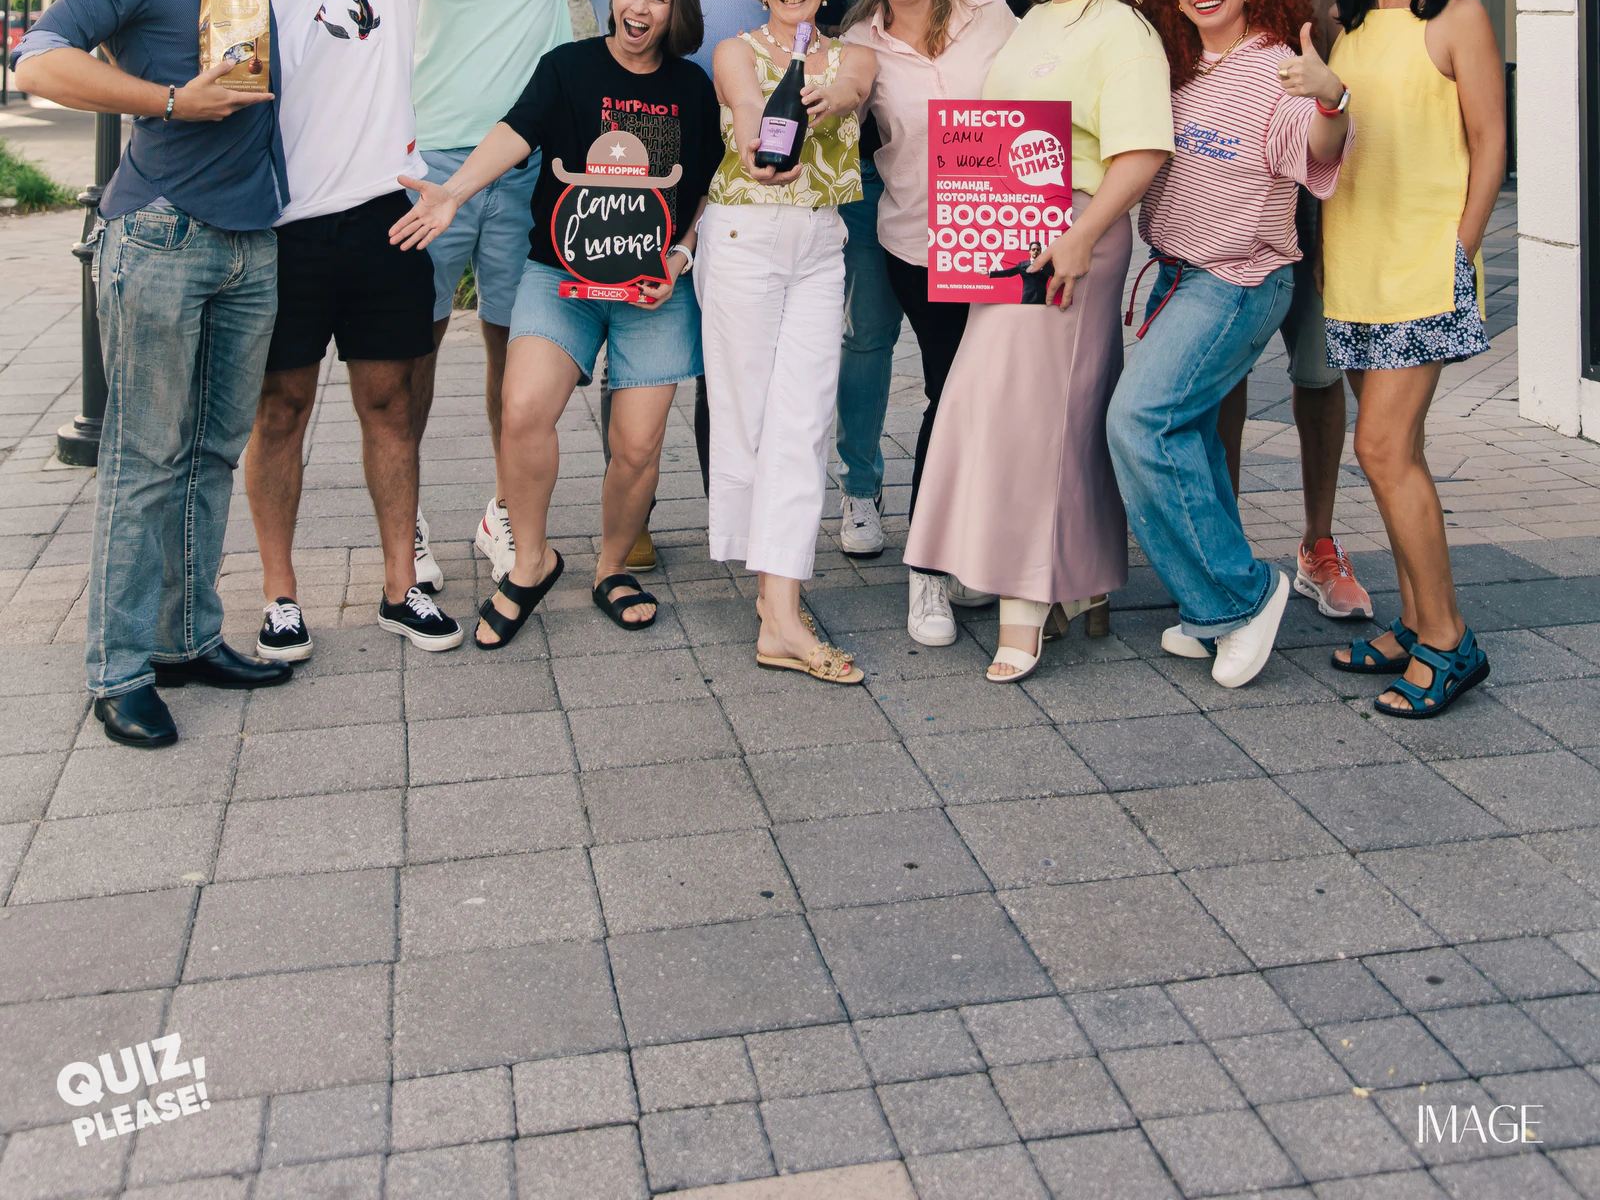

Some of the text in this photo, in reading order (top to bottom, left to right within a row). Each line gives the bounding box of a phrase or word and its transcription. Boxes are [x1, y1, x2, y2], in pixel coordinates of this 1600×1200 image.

[602, 96, 679, 117] Я ИГРАЮ В
[938, 110, 1025, 128] 1 МЕСТО
[1010, 137, 1062, 162] КВИЗ,
[1189, 140, 1237, 160] France
[588, 165, 646, 176] ЧАК НОРРИС
[1011, 152, 1064, 177] ПЛИЗ!
[936, 180, 993, 192] КОМАНДЕ,
[577, 188, 645, 221] Сами
[936, 193, 1045, 204] КОТОРАЯ РАЗНЕСЛА
[585, 226, 661, 260] шоке!
[936, 251, 1005, 273] ВСЕХ
[591, 289, 622, 298] CHUCK
